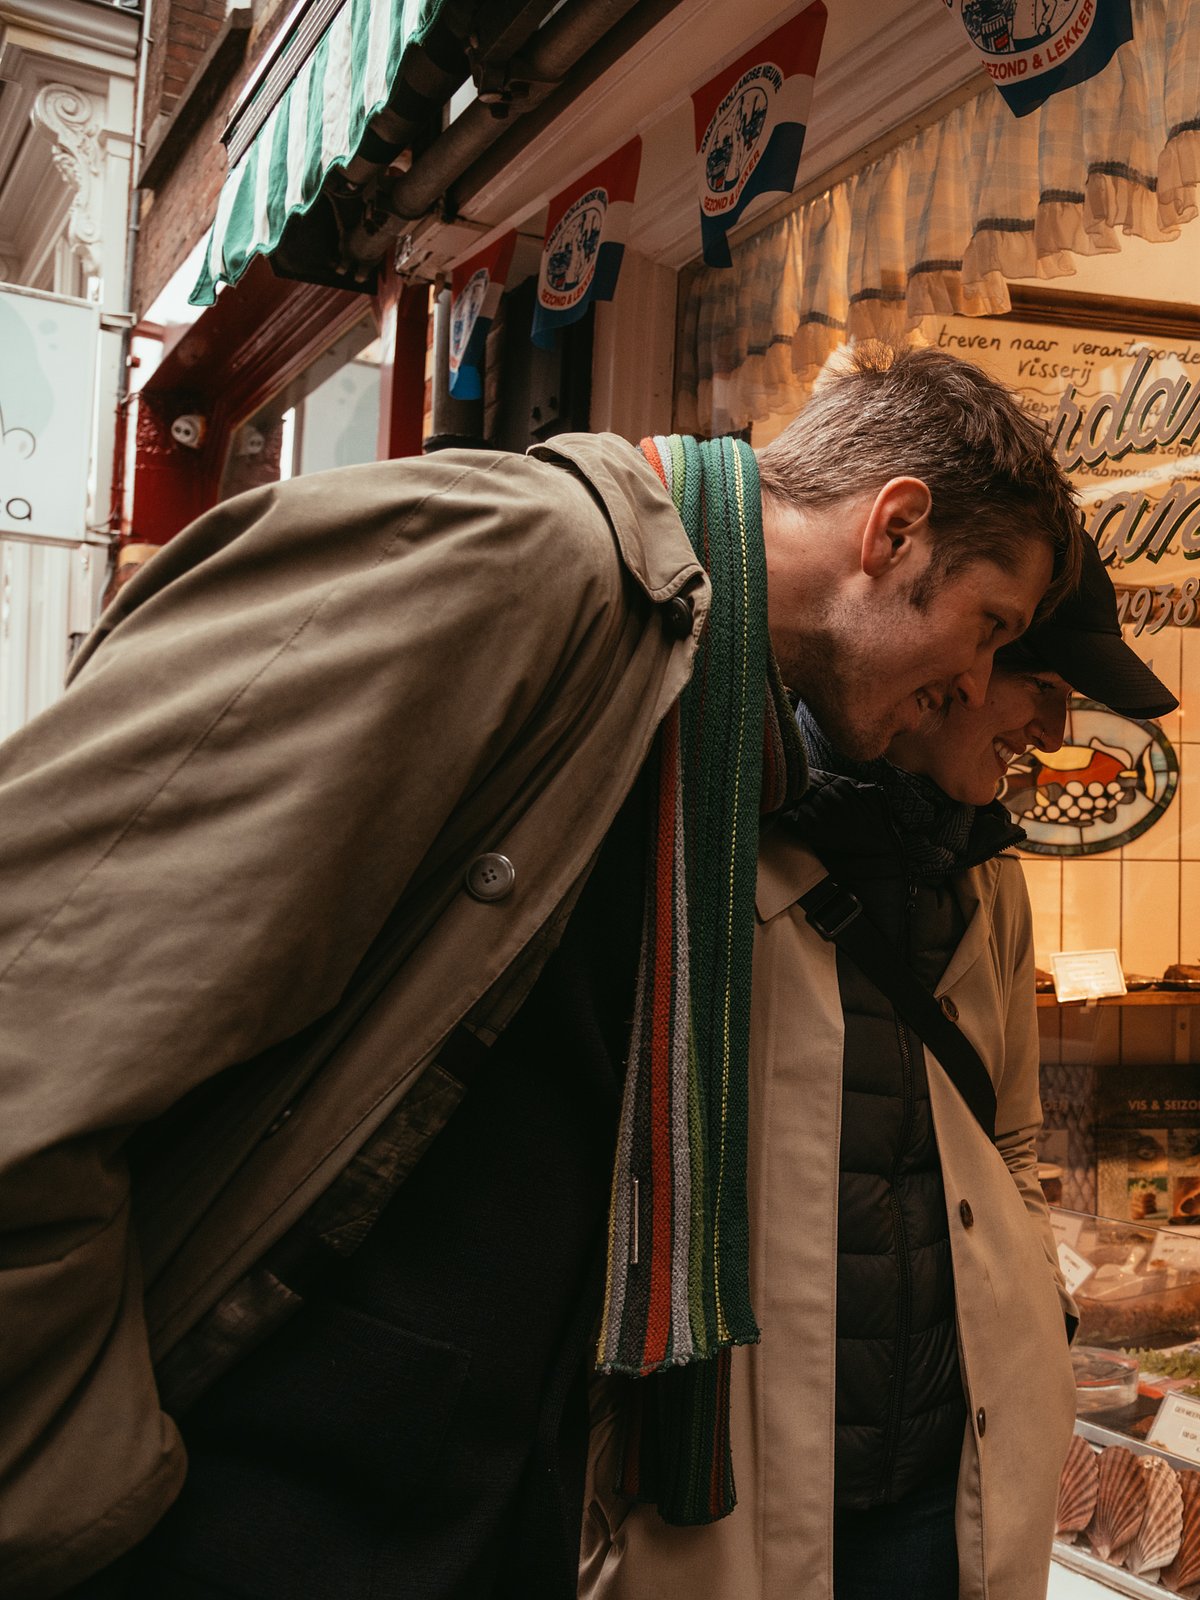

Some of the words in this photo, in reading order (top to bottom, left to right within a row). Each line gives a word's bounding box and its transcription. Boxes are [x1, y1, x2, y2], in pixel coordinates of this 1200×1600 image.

[1032, 53, 1043, 71] &
[1046, 1, 1095, 64] LEKKER
[718, 66, 763, 116] HOLLANDSE
[703, 195, 728, 213] GEZOND
[728, 191, 736, 206] &
[937, 323, 1002, 352] treven
[1010, 337, 1058, 352] naar
[1127, 1100, 1148, 1111] VIS
[1151, 1101, 1161, 1111] &
